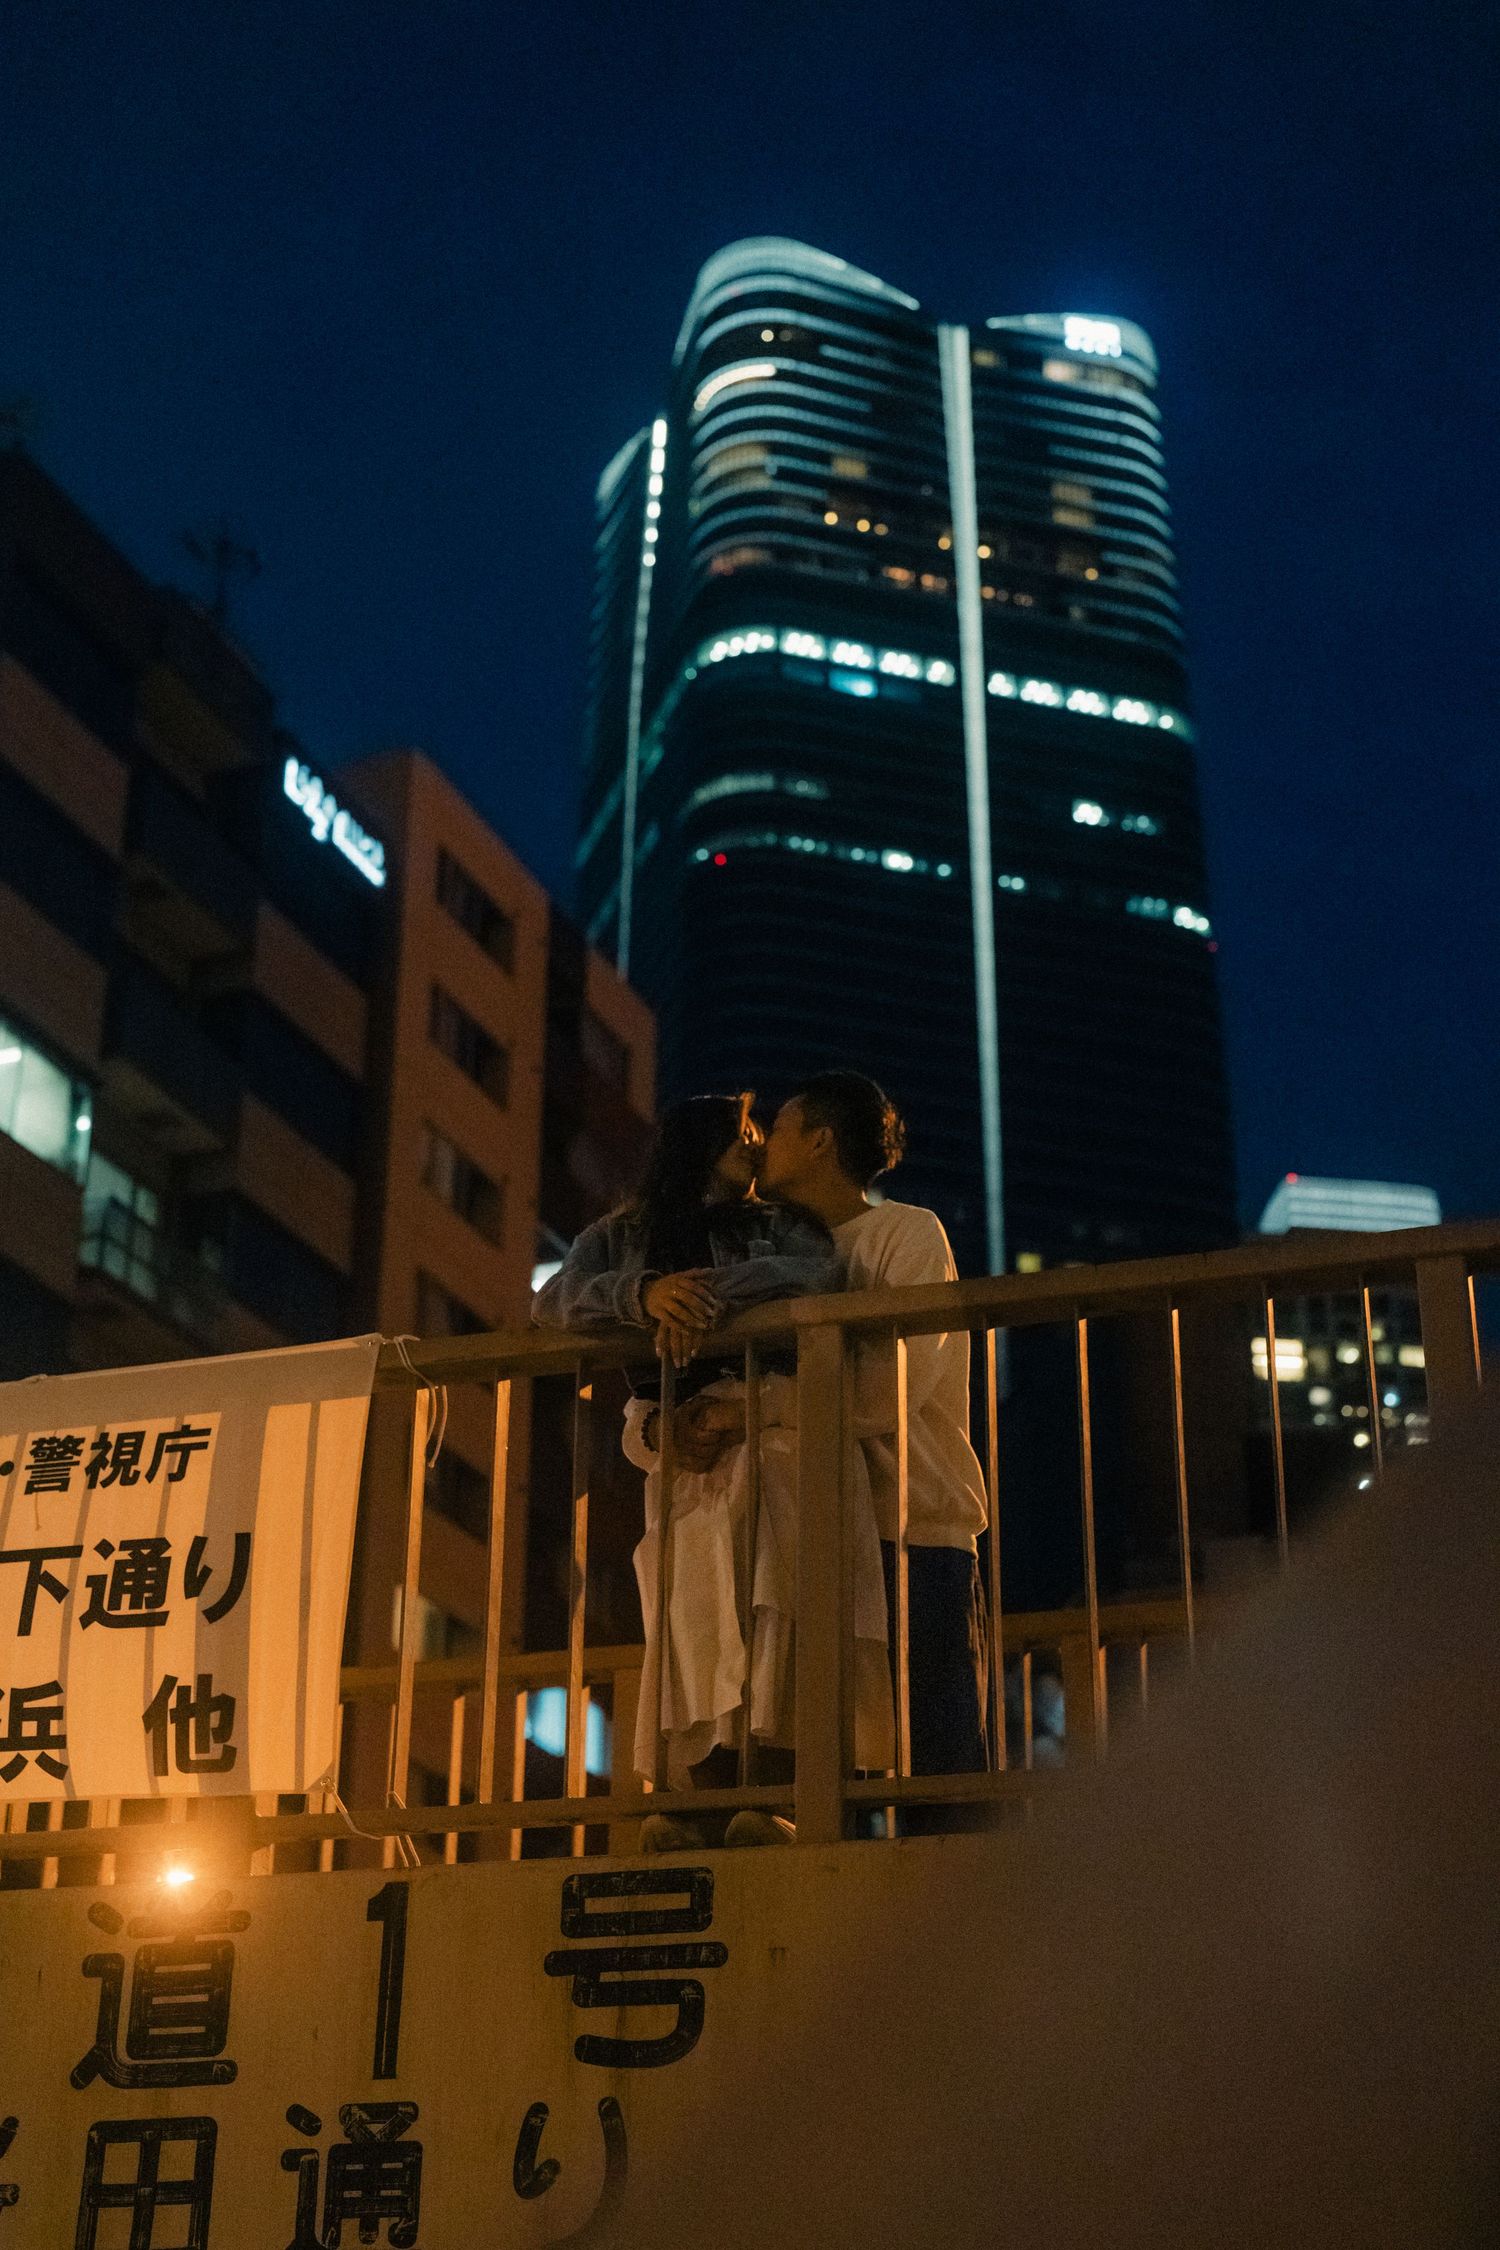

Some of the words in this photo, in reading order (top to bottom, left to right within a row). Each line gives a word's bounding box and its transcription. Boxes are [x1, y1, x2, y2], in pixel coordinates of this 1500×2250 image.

[0, 1532, 252, 1636] 下通り
[0, 2096, 628, 2250] 田通り
